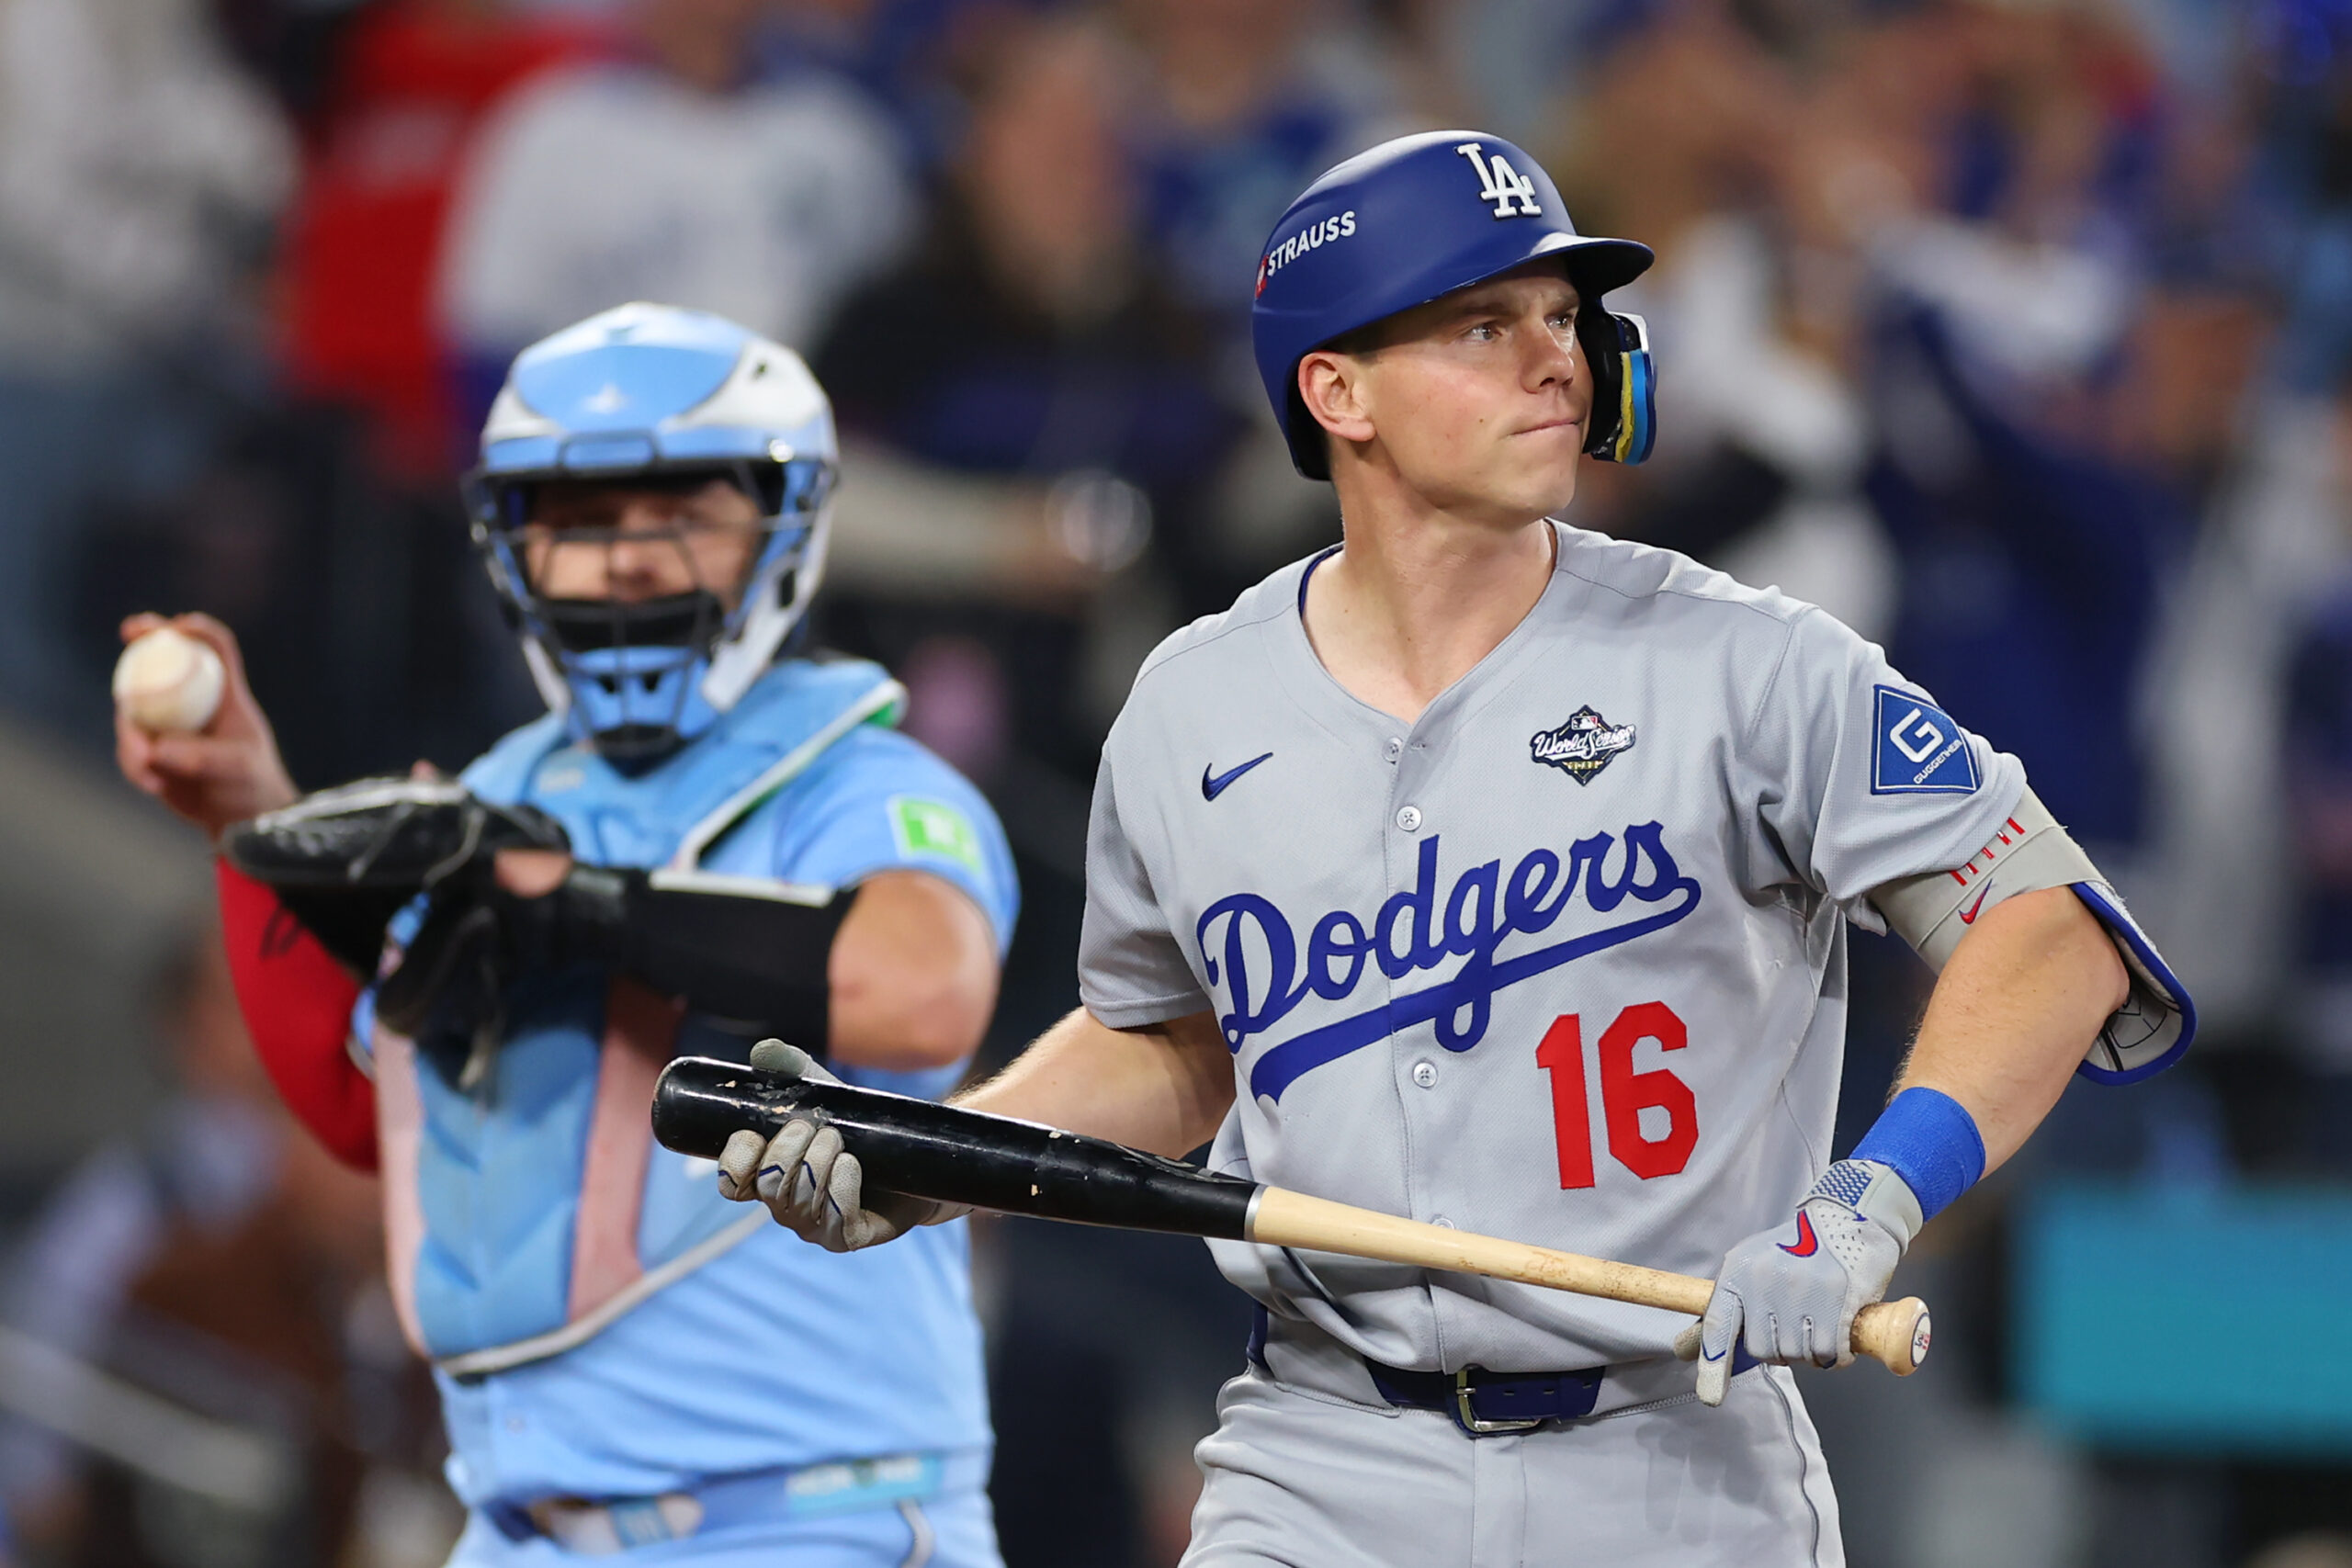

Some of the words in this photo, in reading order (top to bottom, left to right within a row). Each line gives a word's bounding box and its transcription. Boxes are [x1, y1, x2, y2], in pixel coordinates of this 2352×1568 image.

[1457, 142, 1543, 218] LA
[1267, 210, 1356, 276] STRAUSS
[1532, 731, 1589, 758] World
[1889, 707, 1945, 763] G
[1196, 820, 1702, 1055] Dodgers
[1535, 1000, 1699, 1190] 16
